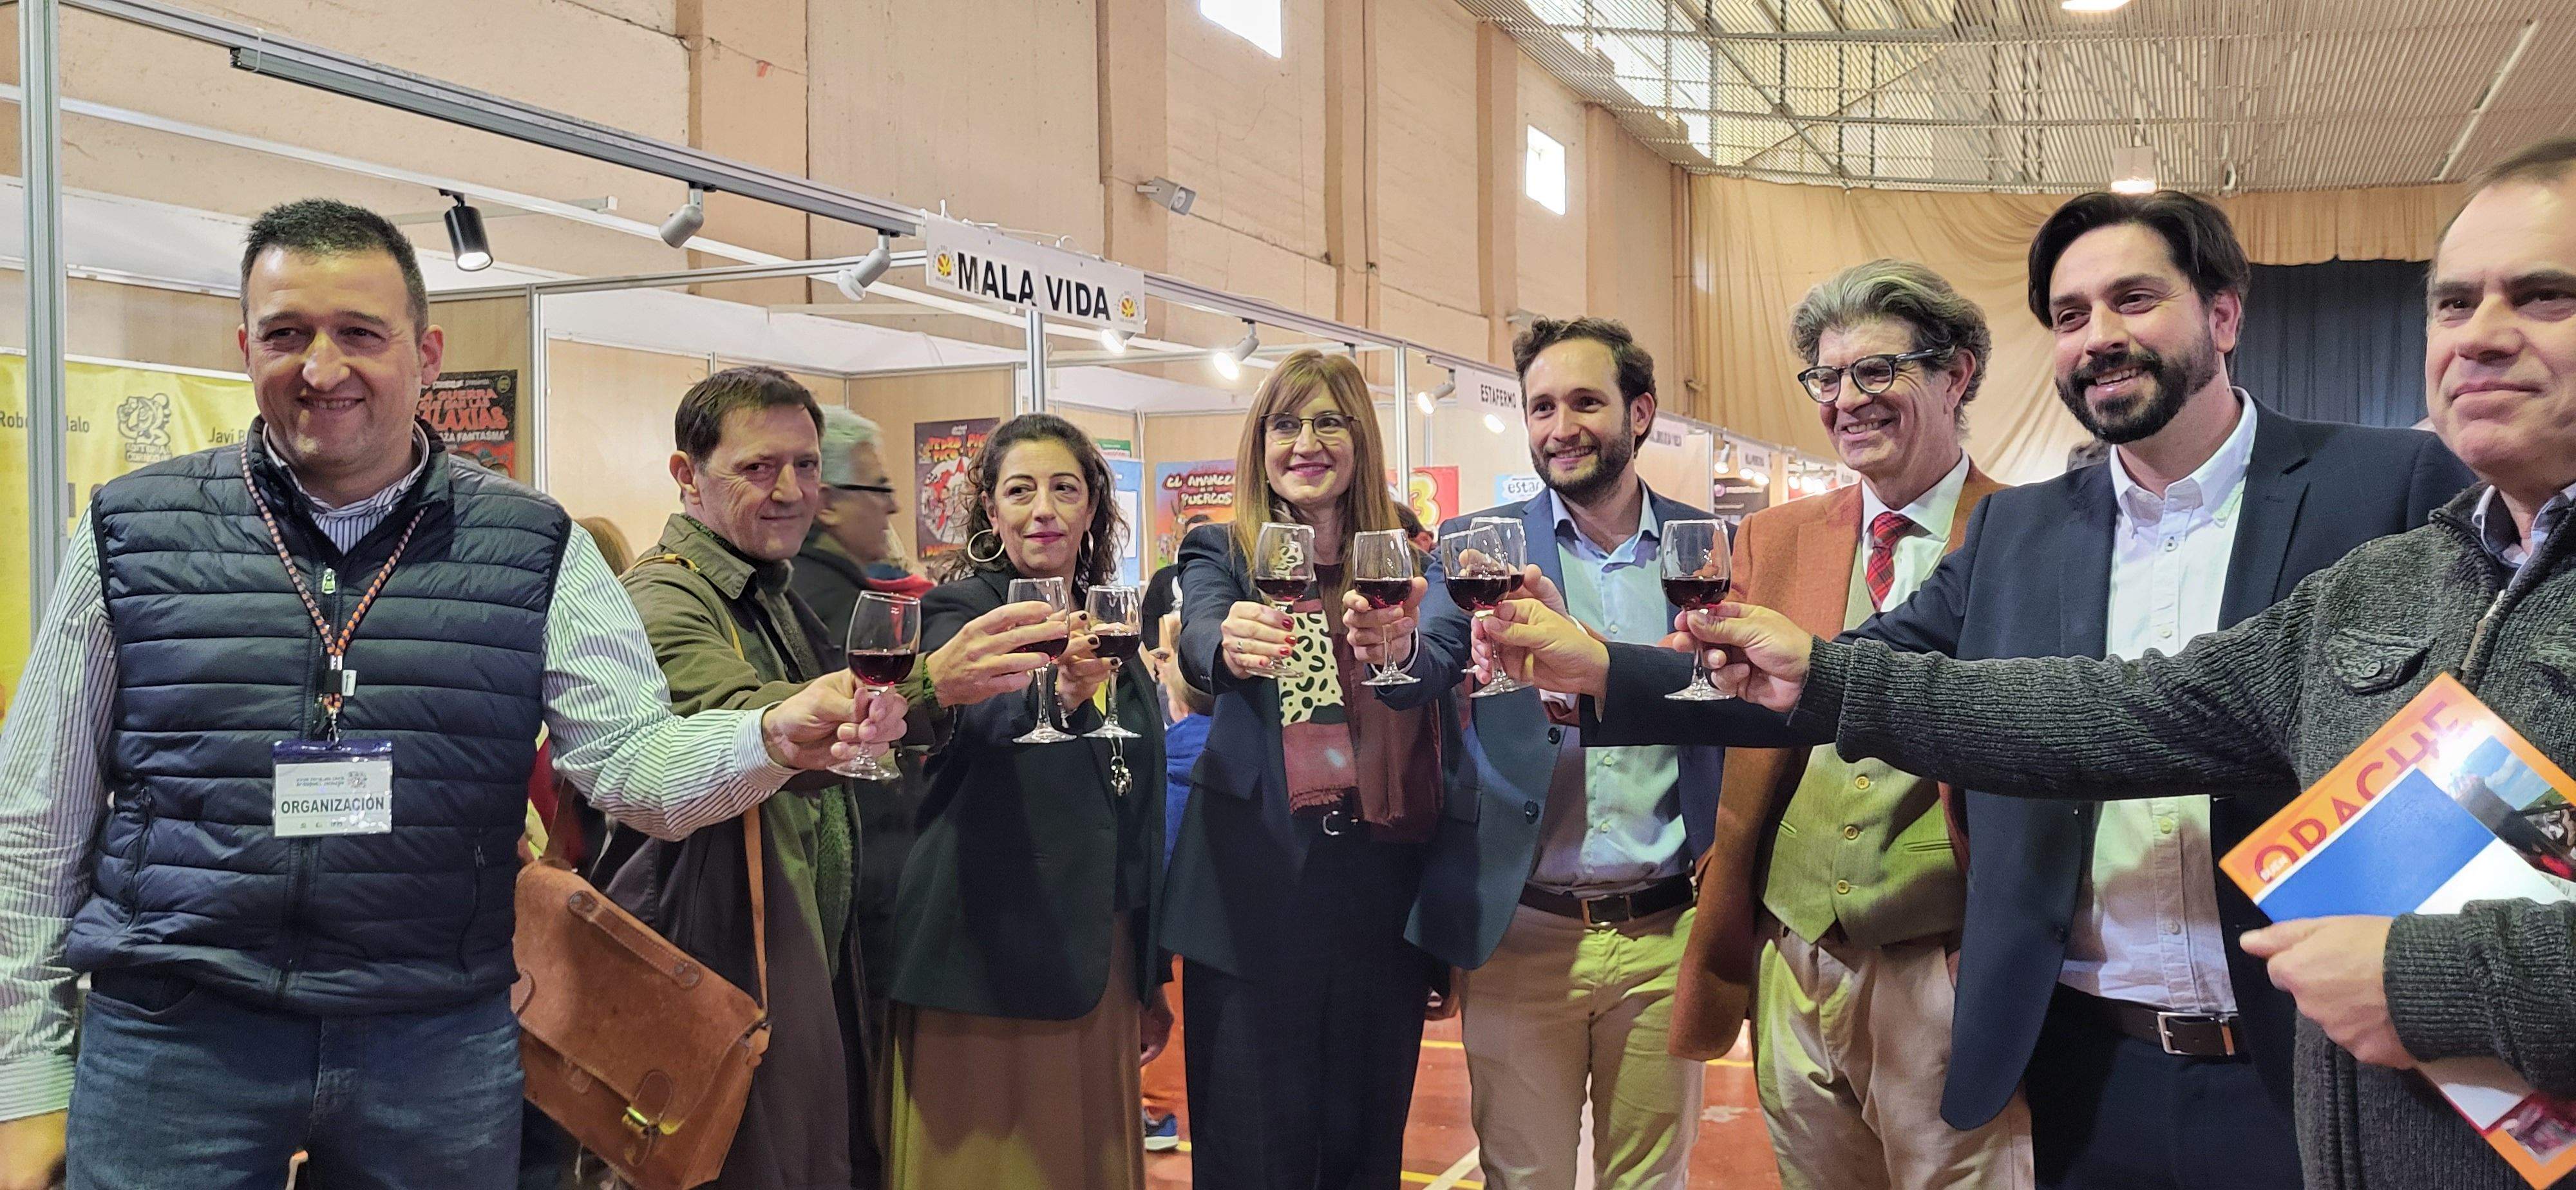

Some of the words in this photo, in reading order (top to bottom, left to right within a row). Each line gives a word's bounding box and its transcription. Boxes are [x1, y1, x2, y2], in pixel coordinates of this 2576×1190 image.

[957, 252, 1037, 307] MALA
[1045, 274, 1112, 321] VIDA
[1480, 384, 1517, 409] ESTAFERMO
[0, 410, 28, 429] Rob
[66, 415, 90, 433] alo
[421, 406, 508, 431] ALAXIAS
[207, 426, 234, 444] Javi
[1508, 482, 1540, 493] esta
[281, 796, 384, 814] ORGANIZACIÓN
